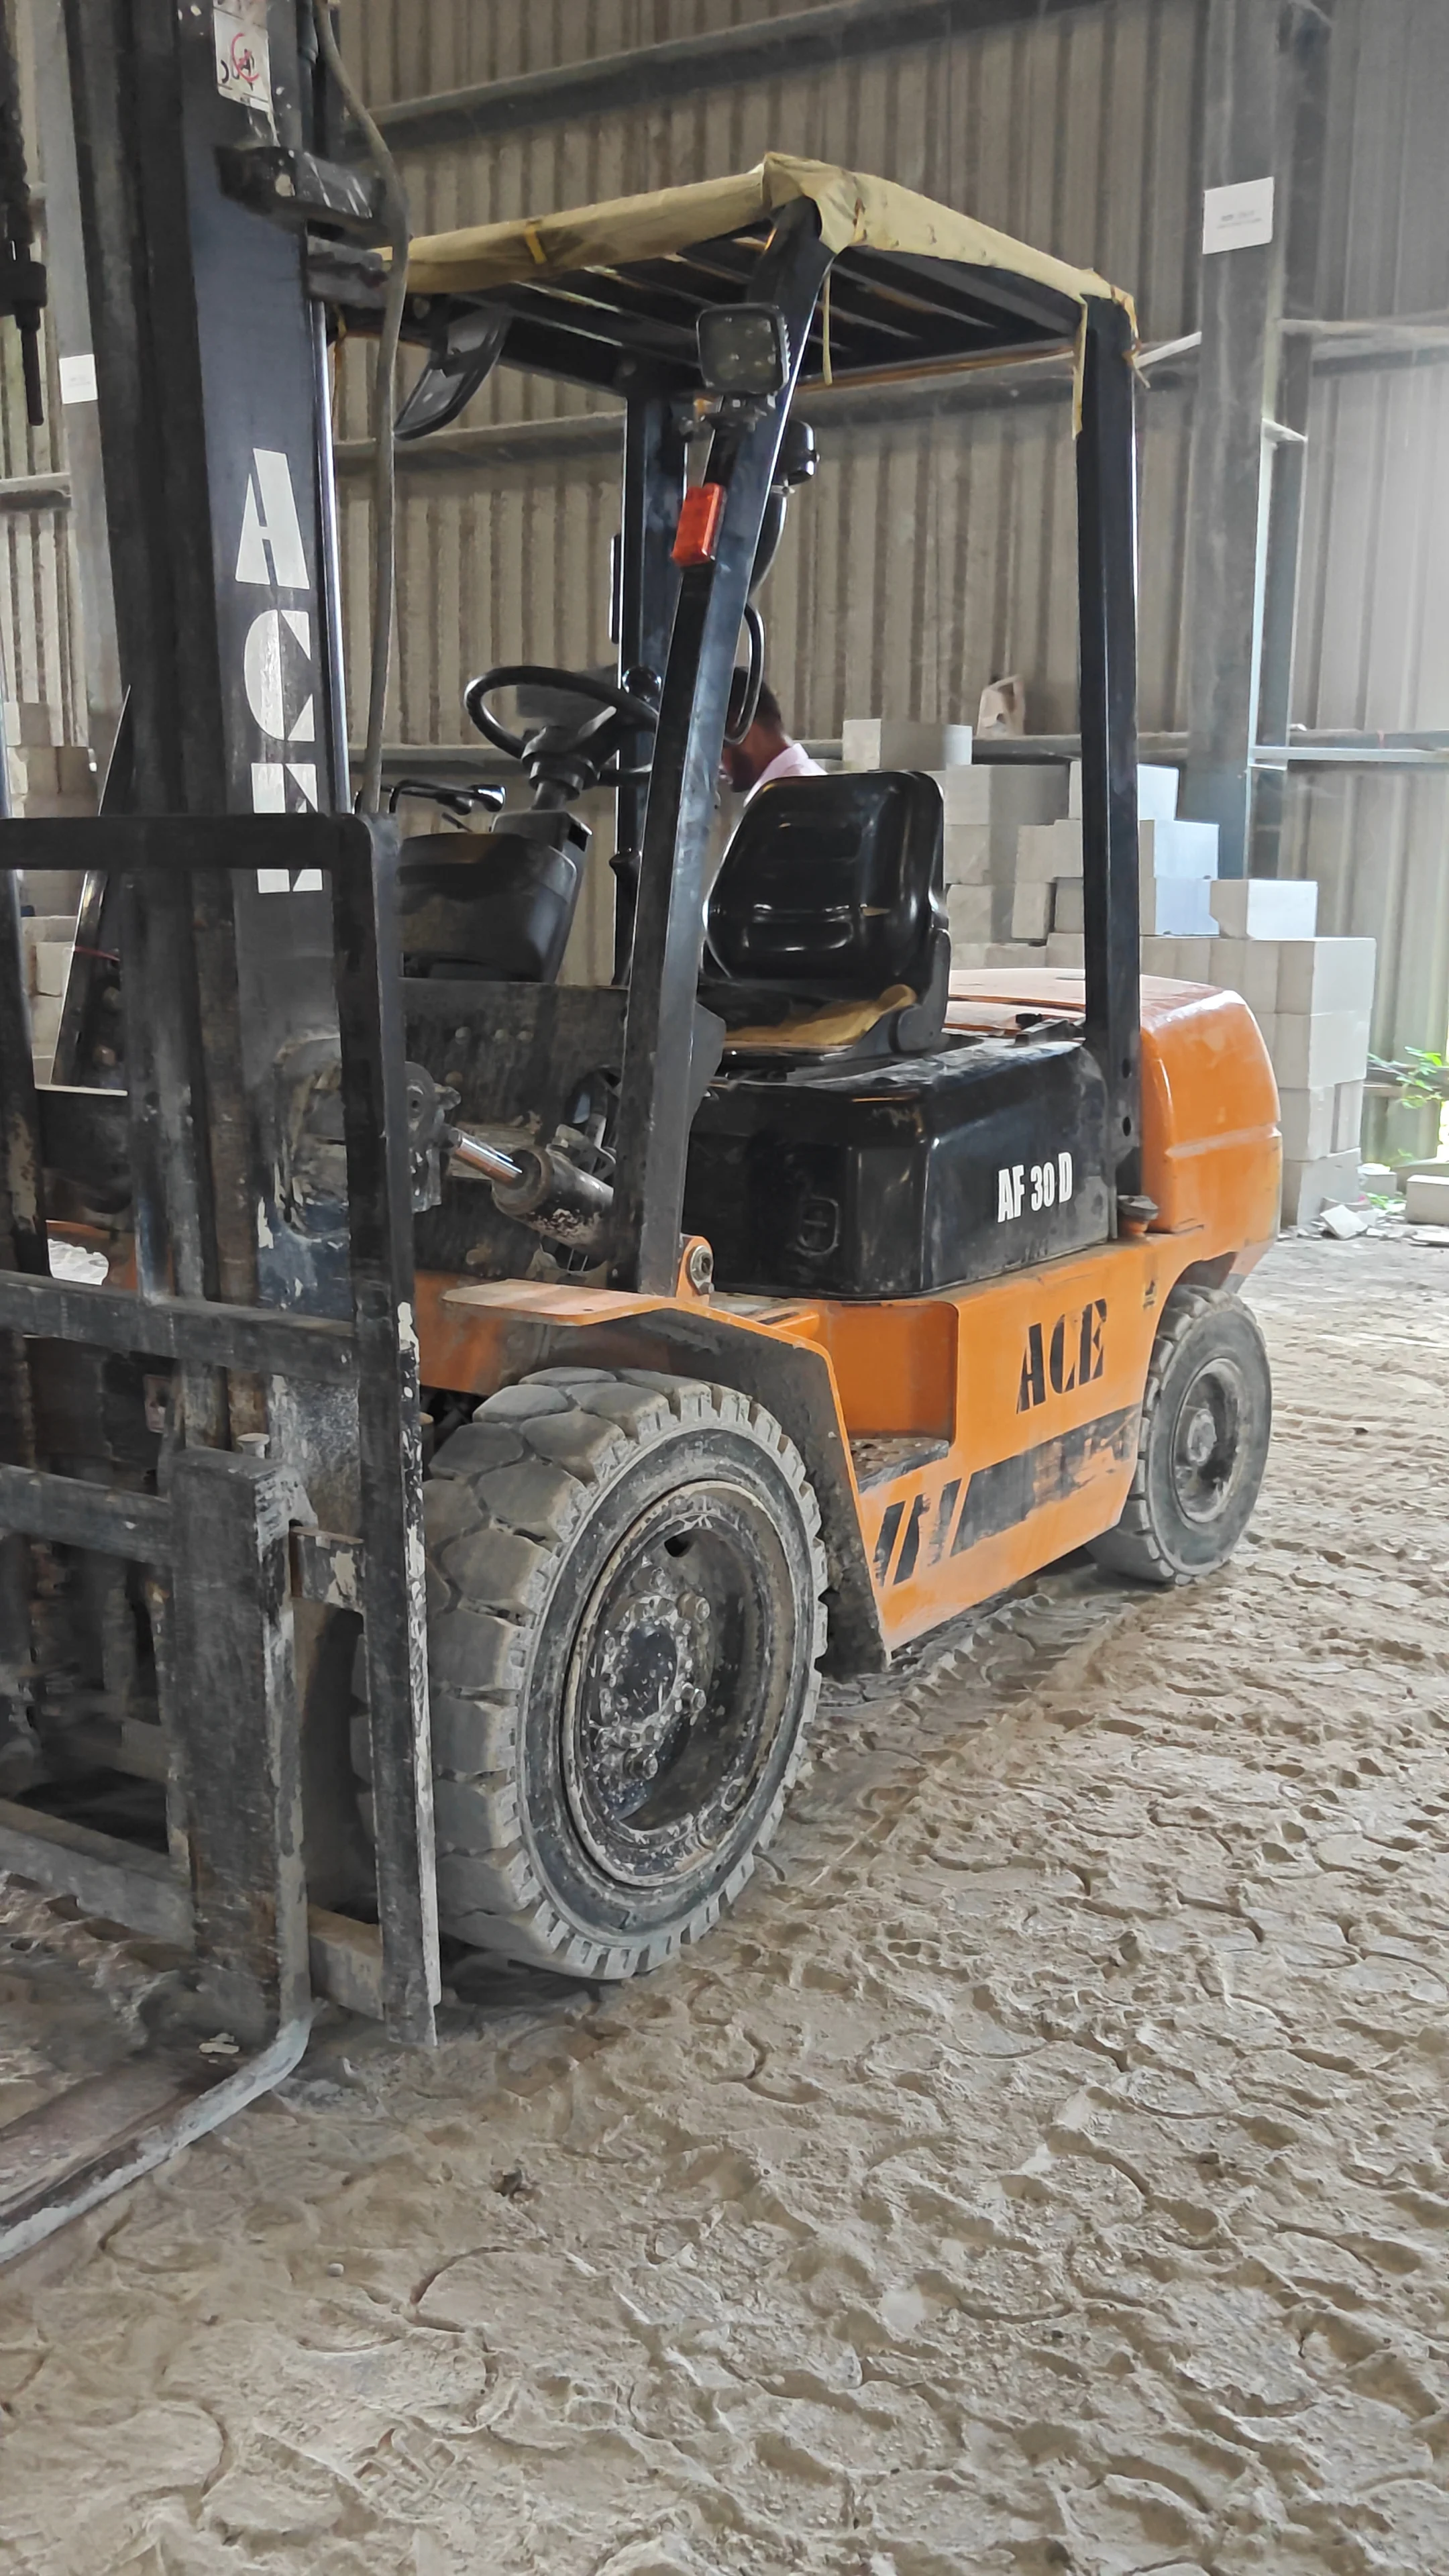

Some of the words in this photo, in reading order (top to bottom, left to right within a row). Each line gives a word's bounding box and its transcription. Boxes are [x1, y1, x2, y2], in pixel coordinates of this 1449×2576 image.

[998, 1165, 1025, 1223] AF
[1030, 1162, 1055, 1212] 30
[1058, 1152, 1073, 1203] D
[1016, 1298, 1107, 1414] ACE
